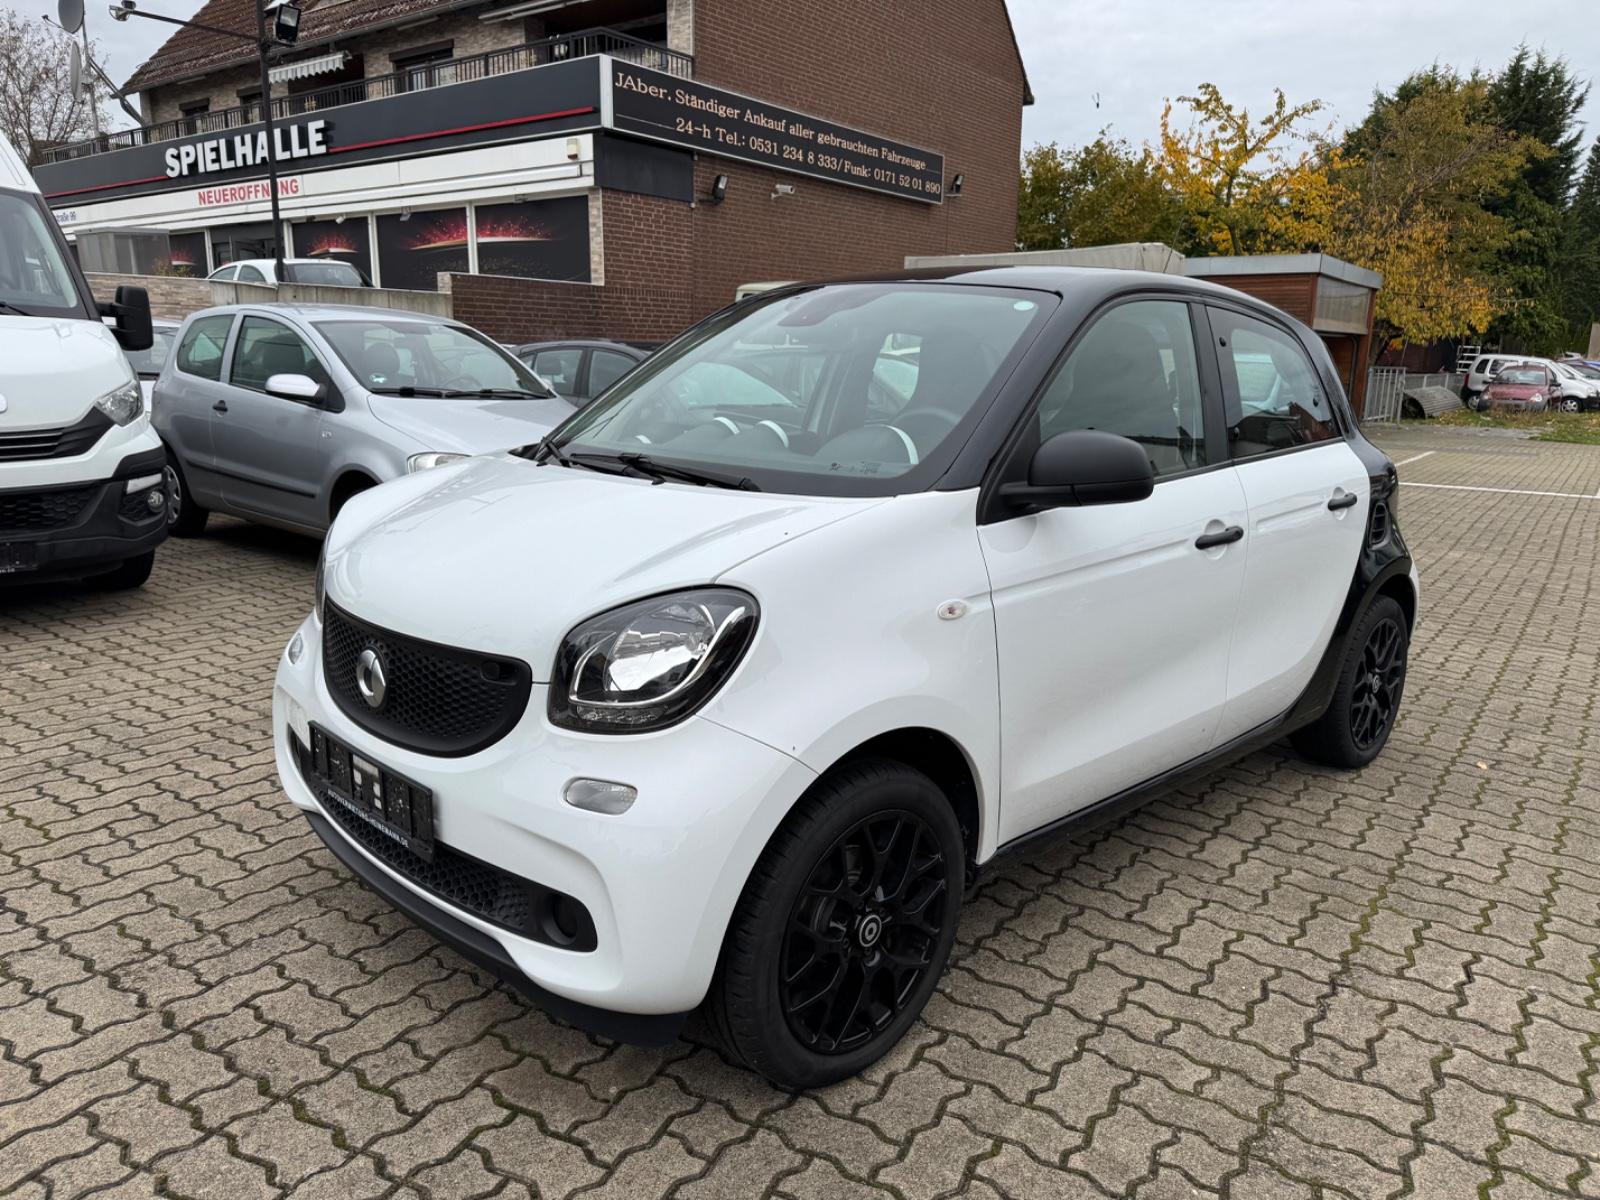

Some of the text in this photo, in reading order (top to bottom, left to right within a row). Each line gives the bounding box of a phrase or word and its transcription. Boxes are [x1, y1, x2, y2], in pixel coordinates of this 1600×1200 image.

[165, 120, 327, 178] SPIELHALLE
[675, 89, 741, 119] Ständiger
[744, 109, 787, 133] Ankauf
[789, 123, 815, 140] aller
[817, 133, 879, 157] gebrauchten
[881, 147, 927, 170] Fahrzeuge
[676, 117, 712, 139] 24-h
[715, 127, 746, 147] Tel.:
[749, 136, 778, 155] 0531
[783, 145, 805, 162] 234
[807, 151, 815, 165] 8
[873, 168, 896, 184] 0171
[899, 174, 911, 188] 52
[911, 177, 923, 191] 01
